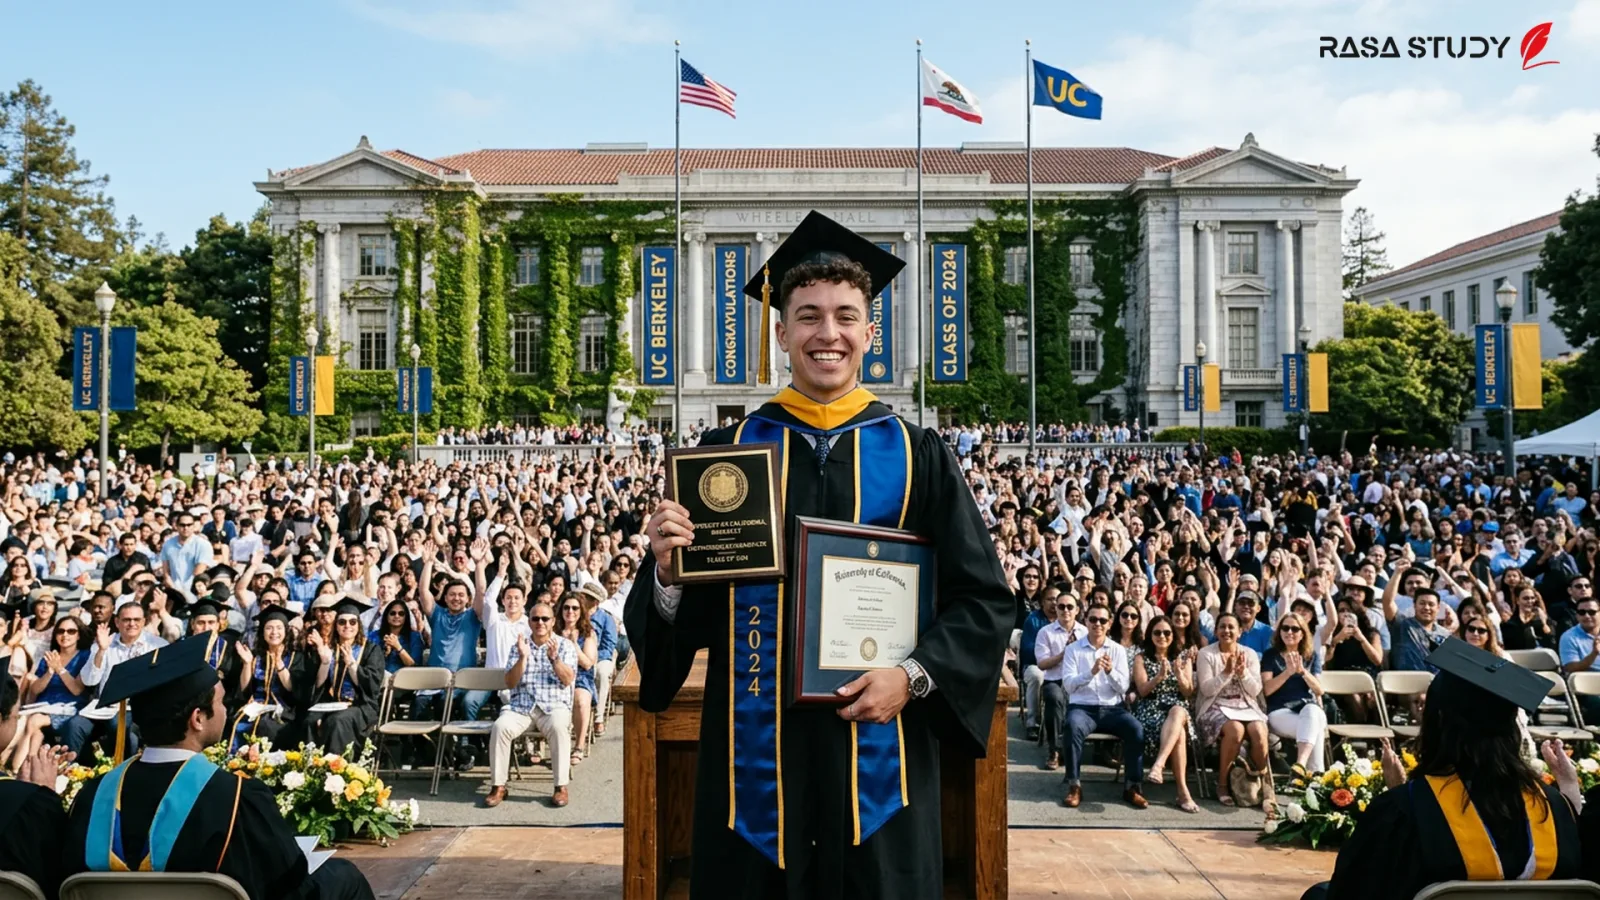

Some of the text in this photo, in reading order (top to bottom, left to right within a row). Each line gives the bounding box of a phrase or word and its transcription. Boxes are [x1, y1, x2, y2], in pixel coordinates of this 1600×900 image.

[1047, 76, 1087, 107] UC
[736, 211, 876, 223] WHEELE HALL
[651, 253, 667, 379] UC BERKELEY
[942, 295, 957, 319] OF
[942, 323, 957, 376] CLASS
[747, 605, 761, 697] 2024
